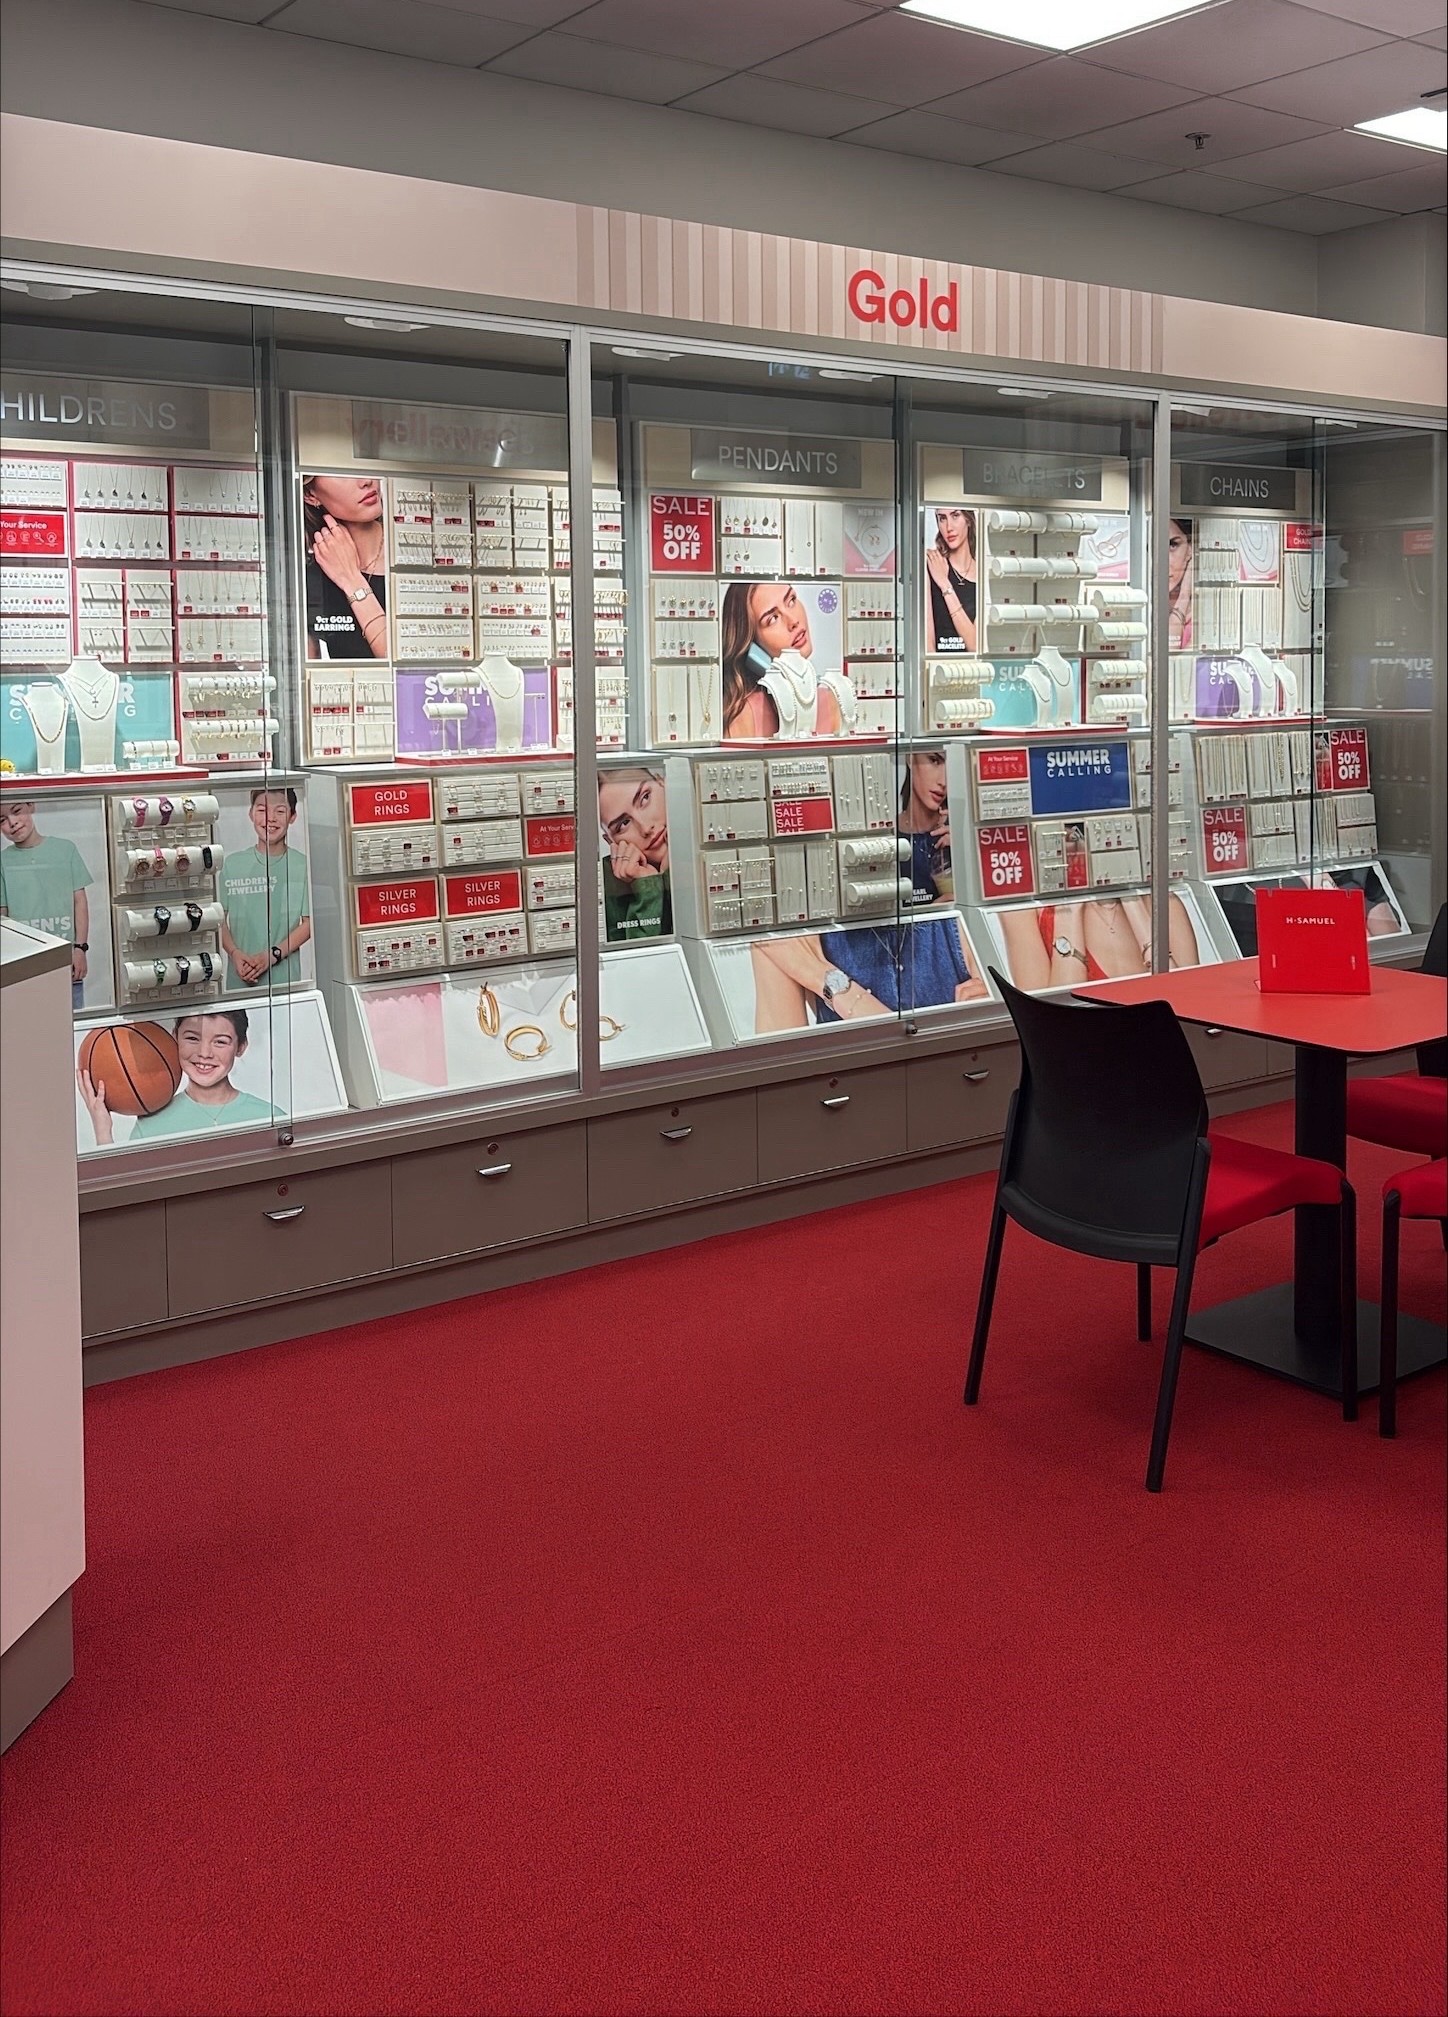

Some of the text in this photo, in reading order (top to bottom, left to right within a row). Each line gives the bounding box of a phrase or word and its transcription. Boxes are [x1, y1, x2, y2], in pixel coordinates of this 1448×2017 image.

[848, 269, 958, 332] Gold
[719, 446, 838, 474] PENDANTS
[983, 463, 1086, 489] BRACETS
[1210, 477, 1269, 498] CHAINS
[653, 496, 710, 515] SALE
[18, 520, 48, 530] Service
[663, 524, 700, 541] 50%
[663, 541, 701, 560] OFF
[330, 615, 354, 624] GOLD
[314, 623, 356, 632] EARRINGS
[1331, 730, 1365, 746] SALE
[1047, 749, 1111, 768] SUMMER
[1337, 751, 1361, 766] 50%
[1047, 765, 1112, 778] CALLING
[1338, 764, 1361, 780] OFF
[374, 790, 408, 802] GOLD
[374, 803, 410, 816] RINGS
[775, 807, 803, 818] SALE
[1205, 808, 1243, 825] SALE
[777, 817, 805, 829] SALE
[980, 826, 1027, 845] SALE
[1212, 831, 1238, 847] 50%
[990, 851, 1021, 868] 50%
[1213, 845, 1239, 862] OFF
[224, 876, 278, 888] CHILDREN'S
[991, 867, 1023, 886] OFF
[227, 885, 276, 896] JEWELLERY
[464, 880, 501, 893] SILVER
[378, 889, 417, 901] SILVER
[467, 894, 501, 907] RINGS
[380, 902, 416, 915] RINGS
[617, 917, 661, 929] DRESS RINGS
